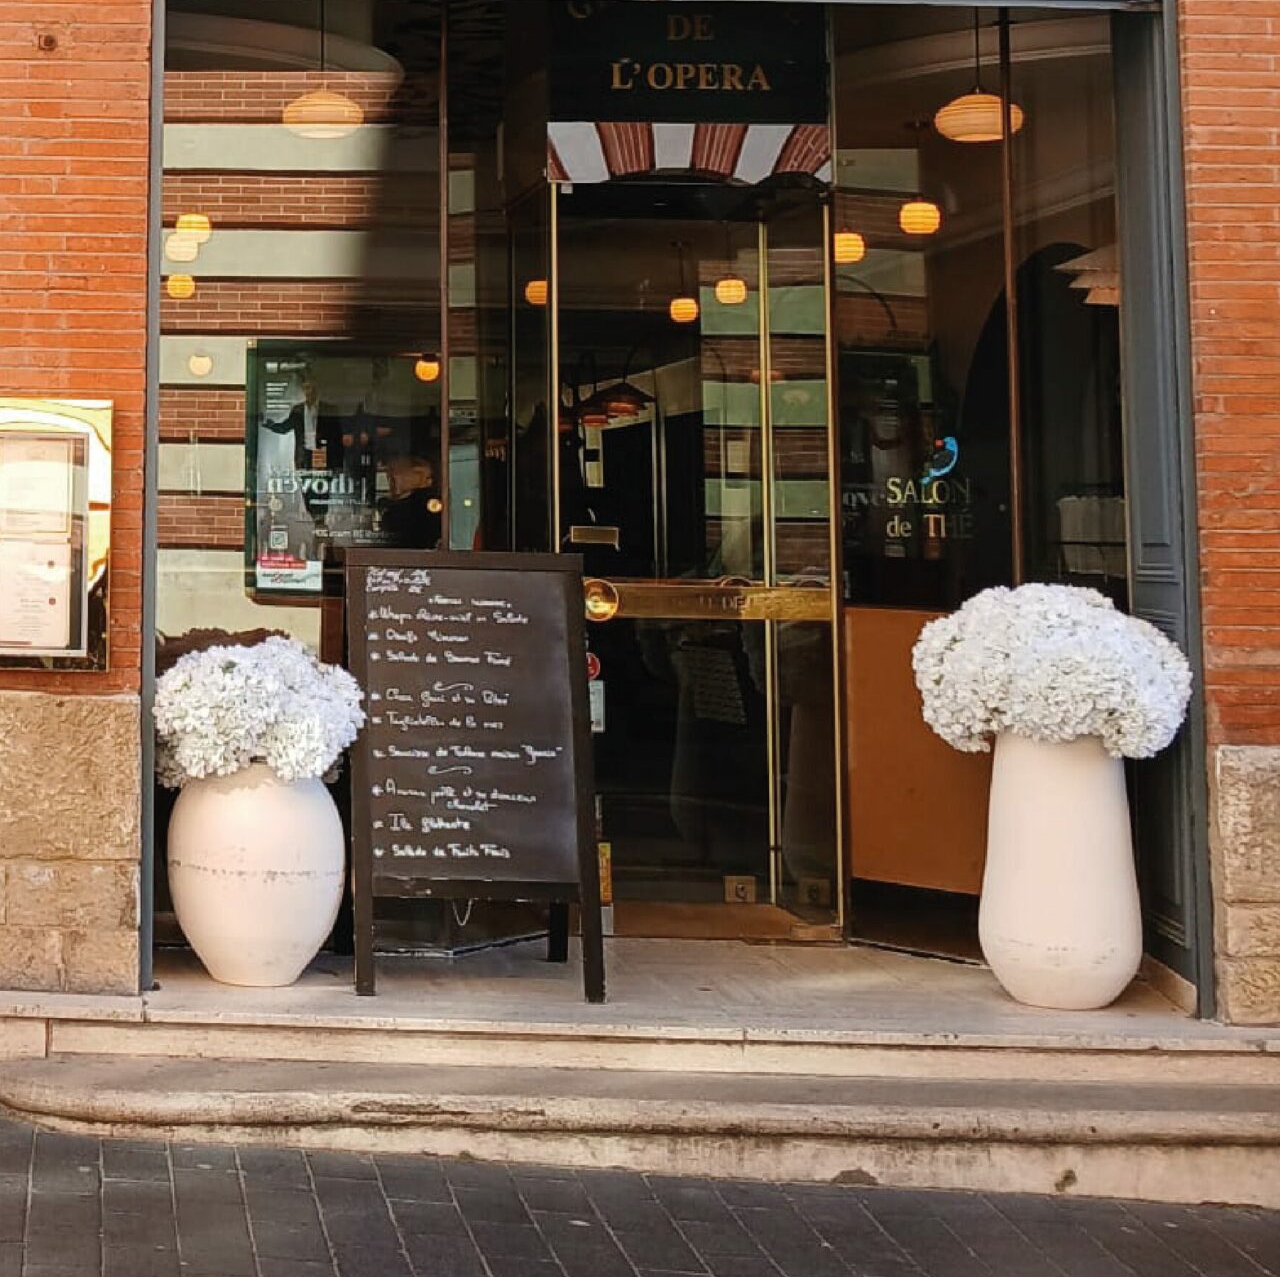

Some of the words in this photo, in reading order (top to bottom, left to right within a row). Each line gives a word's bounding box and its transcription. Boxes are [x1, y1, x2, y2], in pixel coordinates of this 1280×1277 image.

[667, 14, 715, 41] DE
[610, 61, 772, 91] L'OPERA
[886, 476, 971, 504] SALON
[886, 515, 913, 538] de
